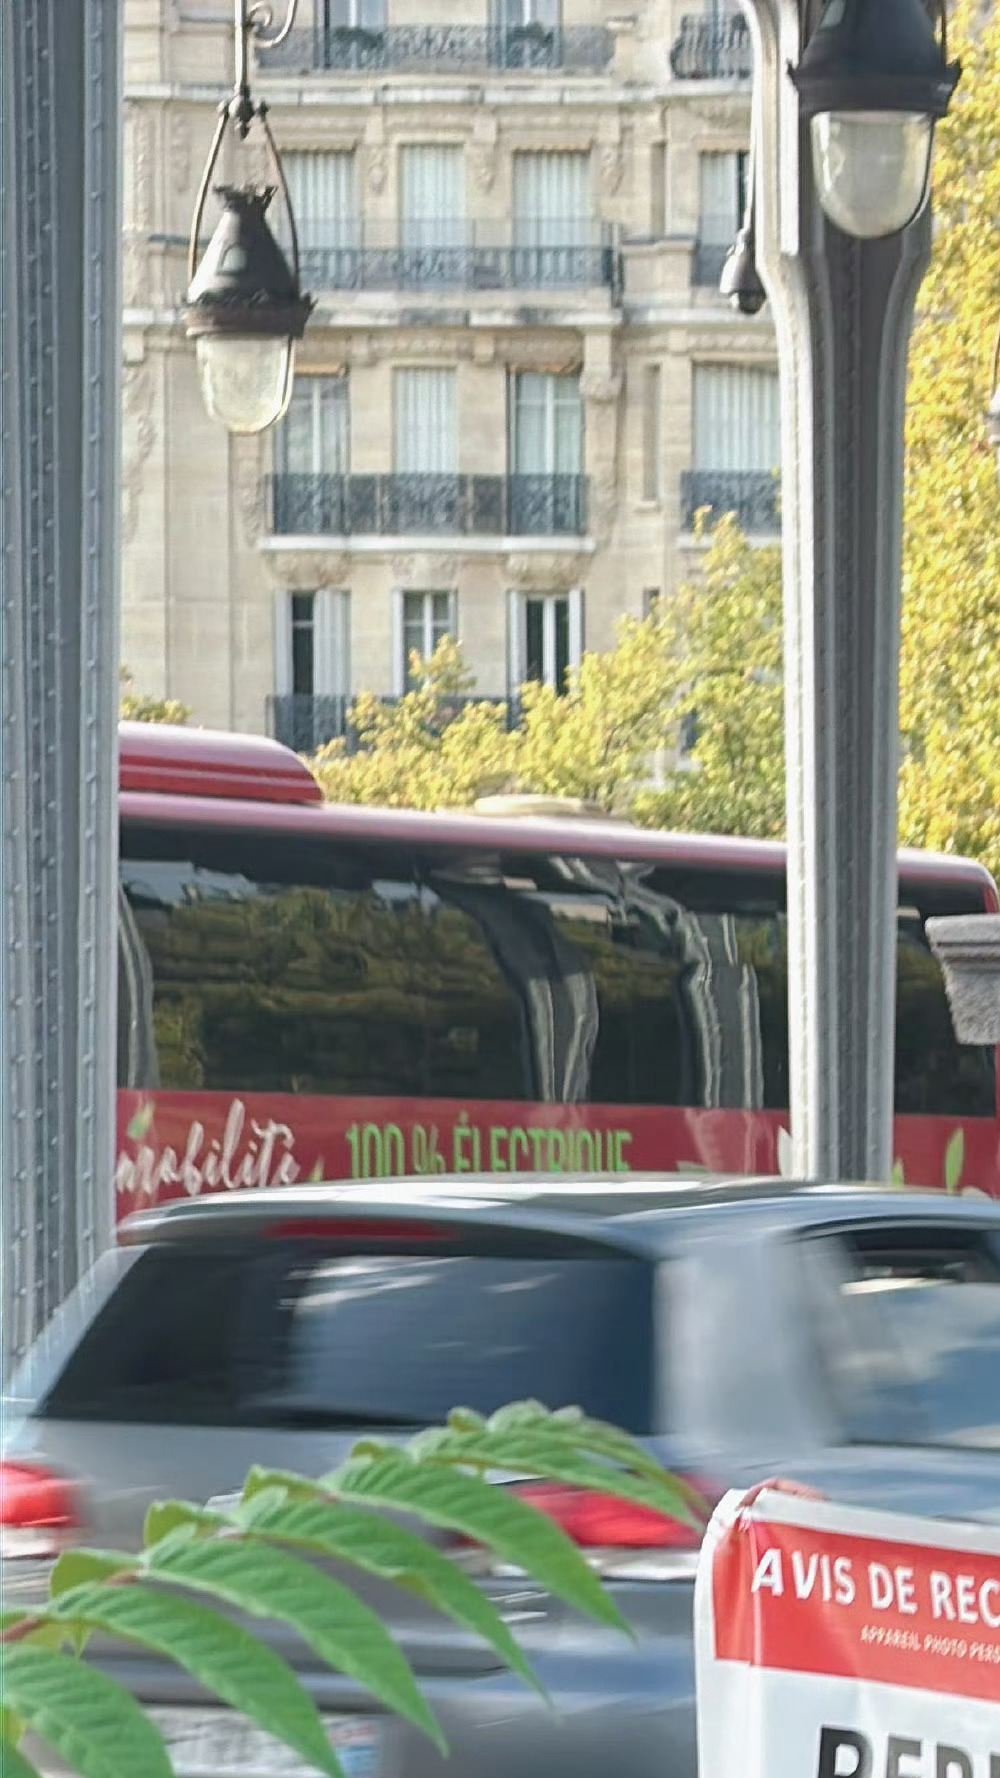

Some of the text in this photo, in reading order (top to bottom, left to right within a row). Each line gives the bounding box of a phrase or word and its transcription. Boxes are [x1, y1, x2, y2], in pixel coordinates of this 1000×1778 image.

[346, 1123, 404, 1178] 100
[454, 1110, 632, 1173] ÉLECTRIQUE
[868, 1562, 918, 1616] DE
[924, 1634, 967, 1658] PHOTO
